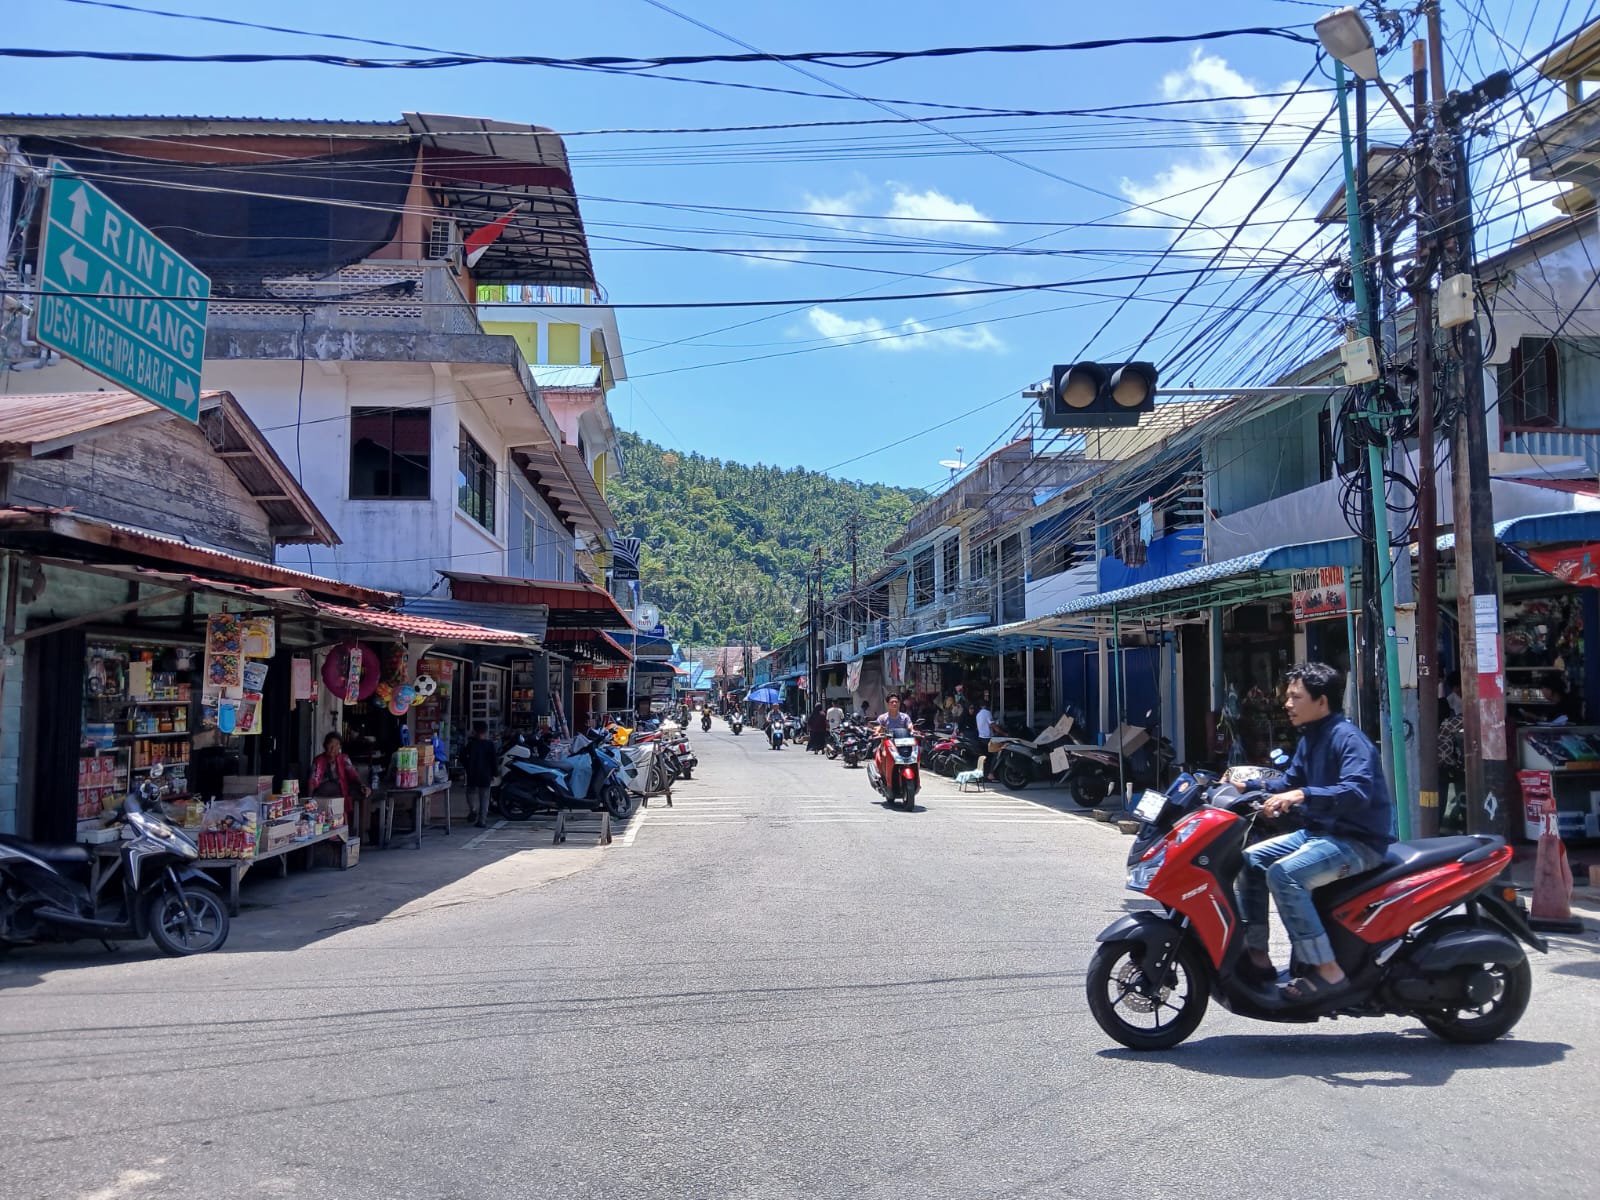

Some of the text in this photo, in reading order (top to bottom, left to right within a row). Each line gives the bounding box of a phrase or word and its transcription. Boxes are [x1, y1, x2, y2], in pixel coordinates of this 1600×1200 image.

[102, 209, 200, 312] RINTIS
[44, 297, 173, 399] DESA TAREMPA BARAT
[96, 270, 196, 360] ANTANG
[1320, 566, 1344, 588] RENTAL
